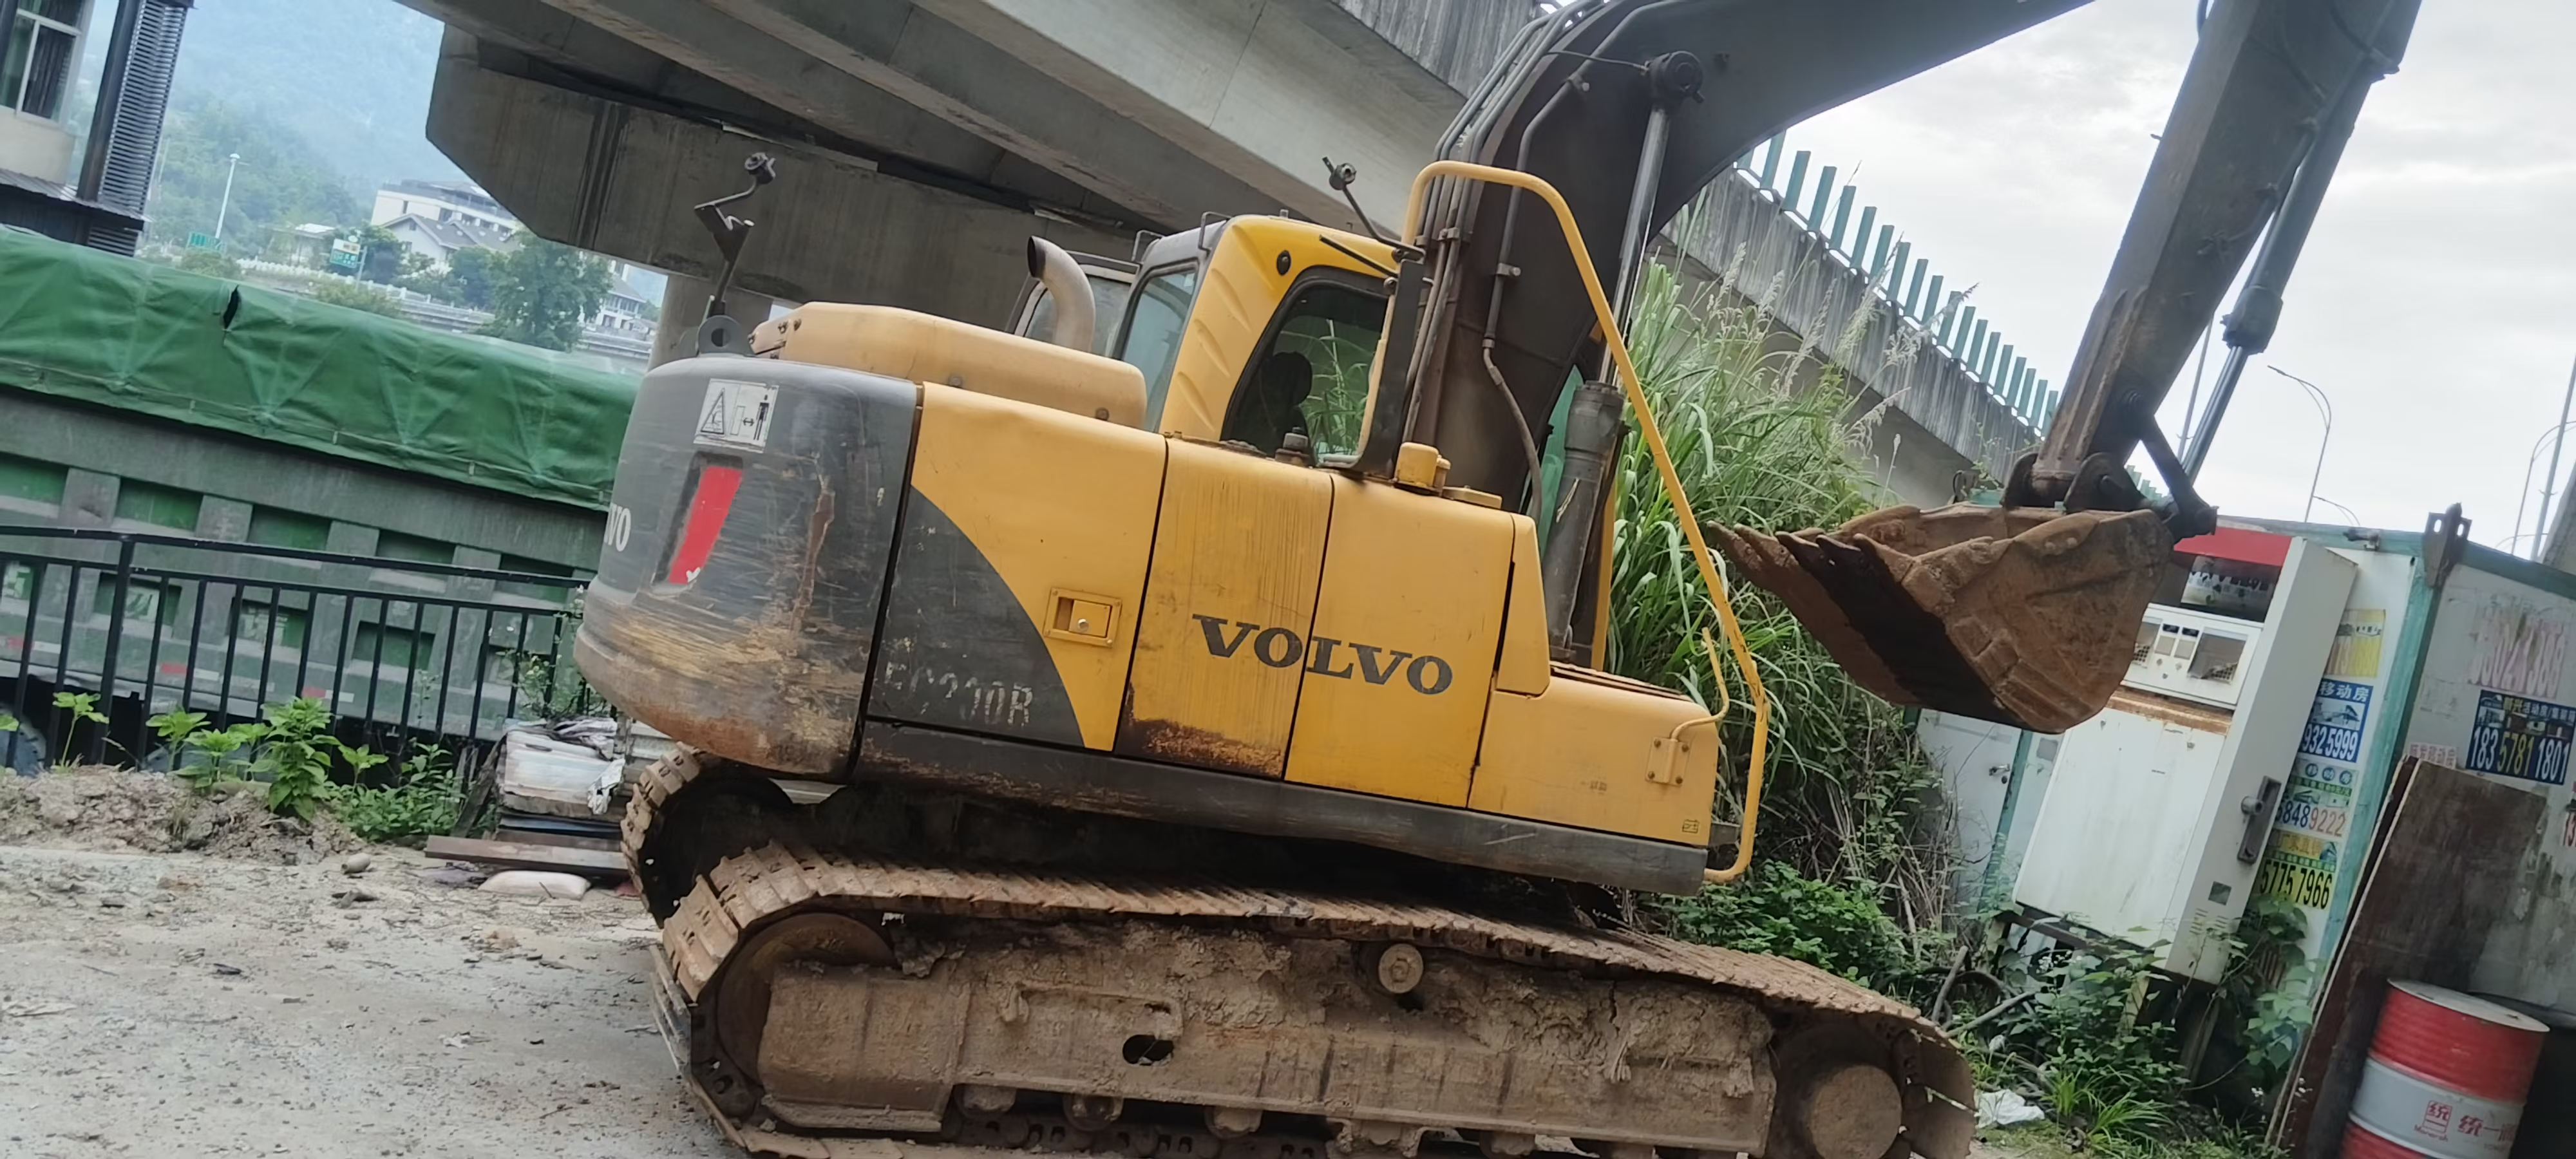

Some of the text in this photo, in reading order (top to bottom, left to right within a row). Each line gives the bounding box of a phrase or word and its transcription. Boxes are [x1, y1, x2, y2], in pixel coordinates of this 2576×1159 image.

[1192, 614, 1452, 695] VOLVO
[2320, 681, 2369, 702] 移动房
[2301, 724, 2359, 762] 9325999
[2471, 726, 2570, 784] 183 5781 1801
